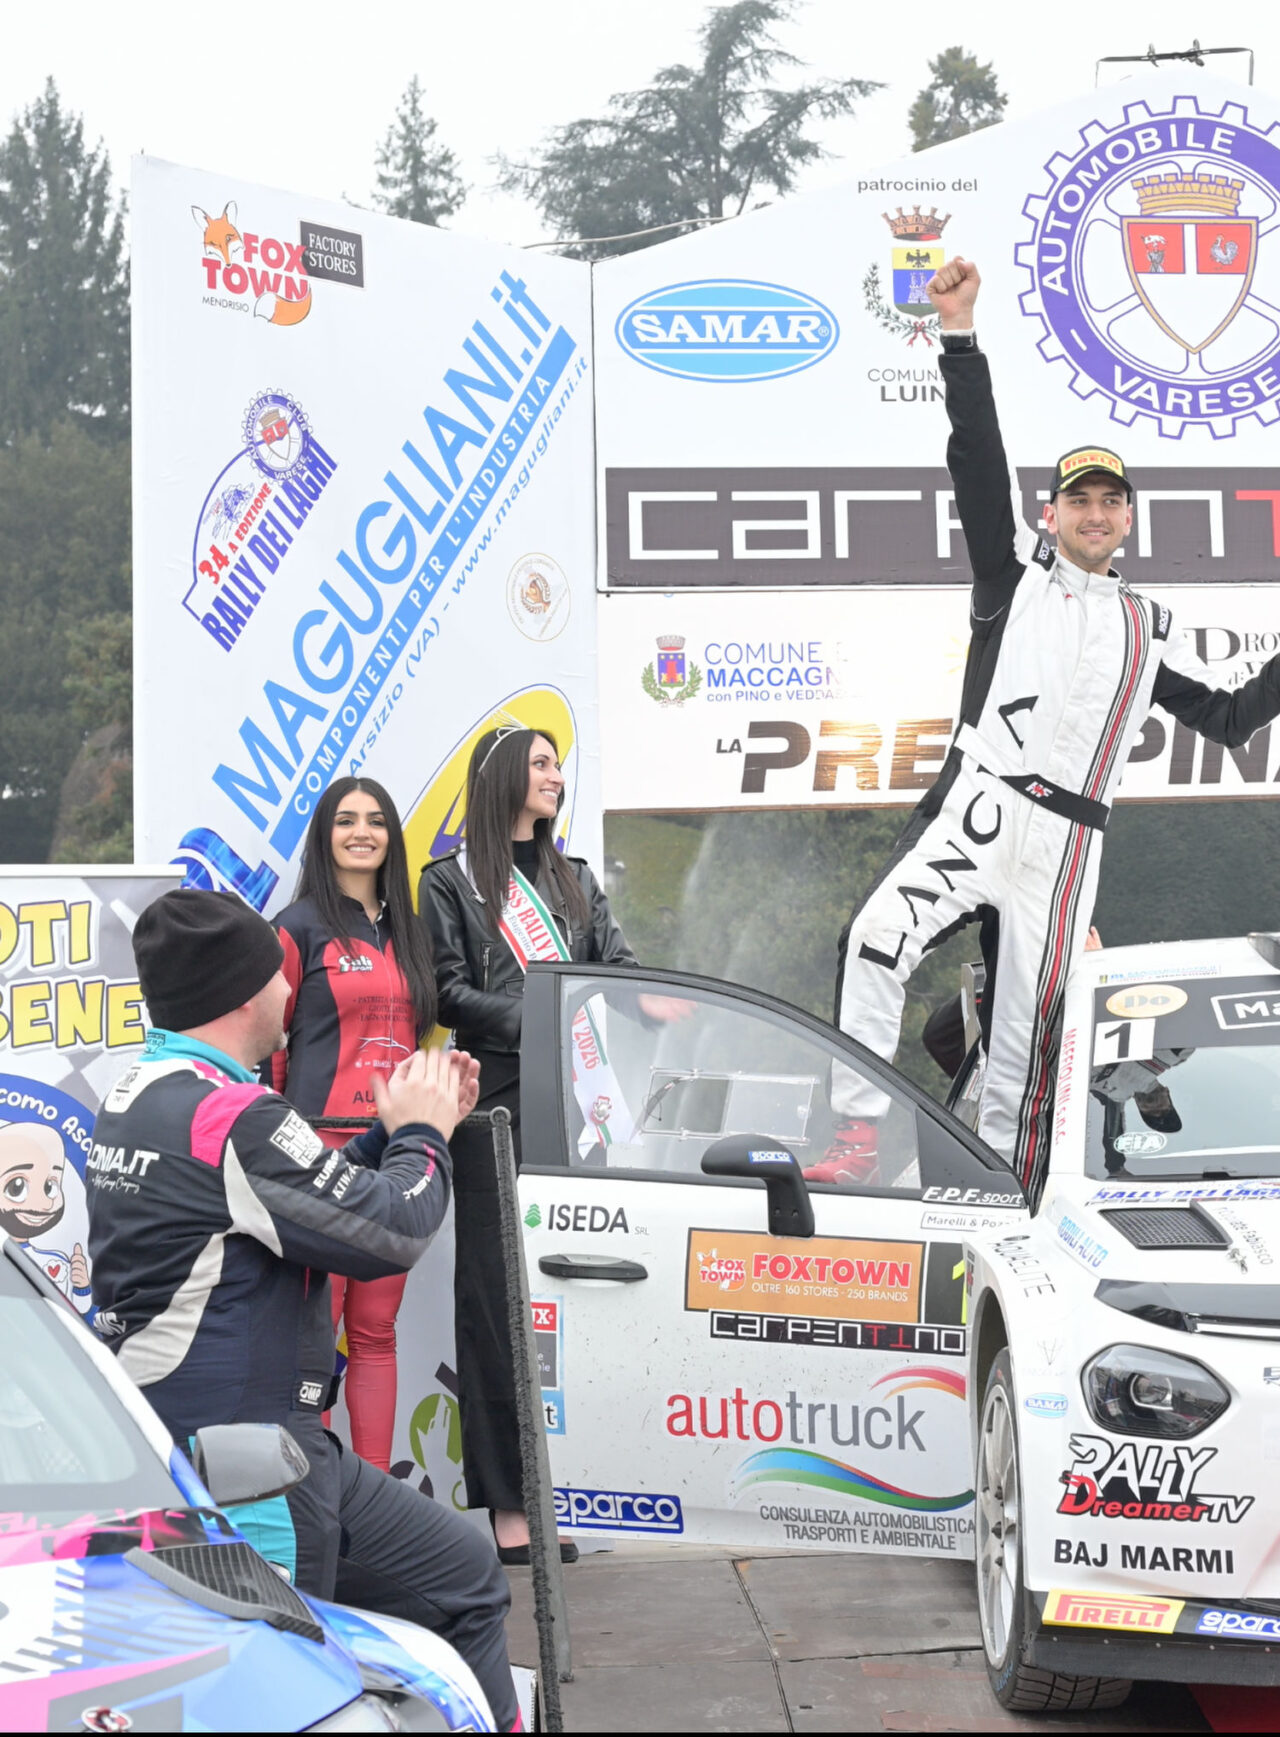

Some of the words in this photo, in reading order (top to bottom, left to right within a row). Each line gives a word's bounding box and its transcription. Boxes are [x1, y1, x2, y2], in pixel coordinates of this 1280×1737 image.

[857, 178, 946, 194] patrocinio
[950, 178, 978, 192] del
[1041, 122, 1236, 296] AUTOMOBILE
[243, 232, 309, 276] FOX
[308, 232, 356, 258] FACTORY
[308, 252, 357, 276] STORES
[202, 258, 309, 302] TOWN
[202, 296, 250, 313] MENDRISIO
[631, 314, 821, 344] SAMAR
[880, 384, 945, 402] LUIN
[404, 615, 441, 679] (VA)
[451, 355, 589, 597] www.magugliani.it
[198, 543, 230, 585] 34
[234, 482, 273, 542] EDIZIONE
[200, 559, 268, 653] RALLY
[246, 508, 295, 576] DEI
[273, 436, 338, 530] LAGHI
[210, 269, 553, 834] MAGUGLIANI.it
[286, 614, 411, 817] COMPONENTI
[408, 553, 447, 610] PER
[443, 374, 553, 549] L'INDUSTRIA
[704, 642, 824, 665] COMUNE
[706, 666, 842, 688] MACCAGN
[706, 692, 732, 702] con
[735, 690, 770, 701] PINO
[774, 692, 782, 701] e
[715, 738, 742, 754] LA
[516, 906, 555, 952] RALLY
[574, 1026, 601, 1071] 2026
[1104, 1021, 1132, 1060] 1
[751, 1151, 790, 1164] sparco
[547, 1203, 630, 1235] ISEDA
[926, 1215, 967, 1227] Marelli
[700, 1271, 745, 1283] TOWN
[716, 1259, 745, 1272] FOX
[752, 1253, 912, 1289] FOXTOWN
[751, 1282, 781, 1295] OLTRE
[784, 1284, 801, 1296] 160
[803, 1285, 839, 1298] STORES
[846, 1288, 865, 1300] 250
[867, 1289, 908, 1302] BRANDS
[666, 1387, 927, 1452] autotruck
[1068, 1433, 1218, 1502] RALLY
[759, 1505, 852, 1528] CONSULENZA
[853, 1510, 977, 1534] AUTOMOBILISTICA
[784, 1524, 859, 1544] TRASPORTI
[860, 1528, 870, 1544] E
[872, 1529, 957, 1551] AMBIENTALE
[1054, 1539, 1109, 1569] BAJ
[1120, 1545, 1235, 1574] MARMI
[1053, 1594, 1172, 1629] PIRELLI
